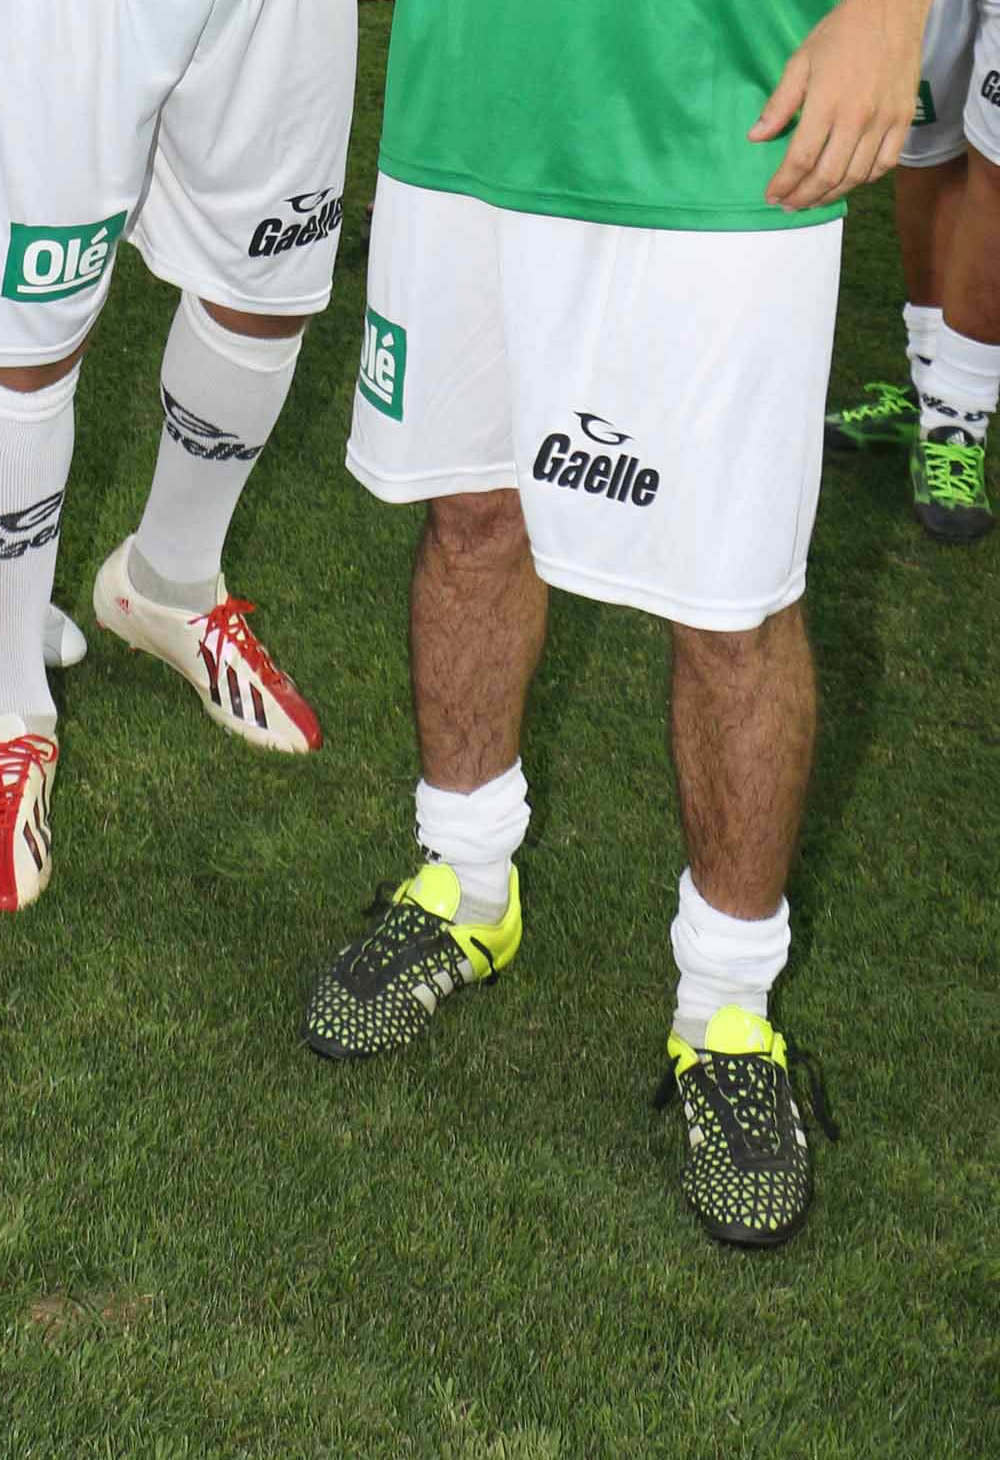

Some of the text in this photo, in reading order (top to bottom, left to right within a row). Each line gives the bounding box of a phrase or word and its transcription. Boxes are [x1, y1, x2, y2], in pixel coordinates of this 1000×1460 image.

[22, 226, 109, 287] Olé
[248, 195, 344, 257] Gaelle
[532, 432, 660, 508] Gaelle
